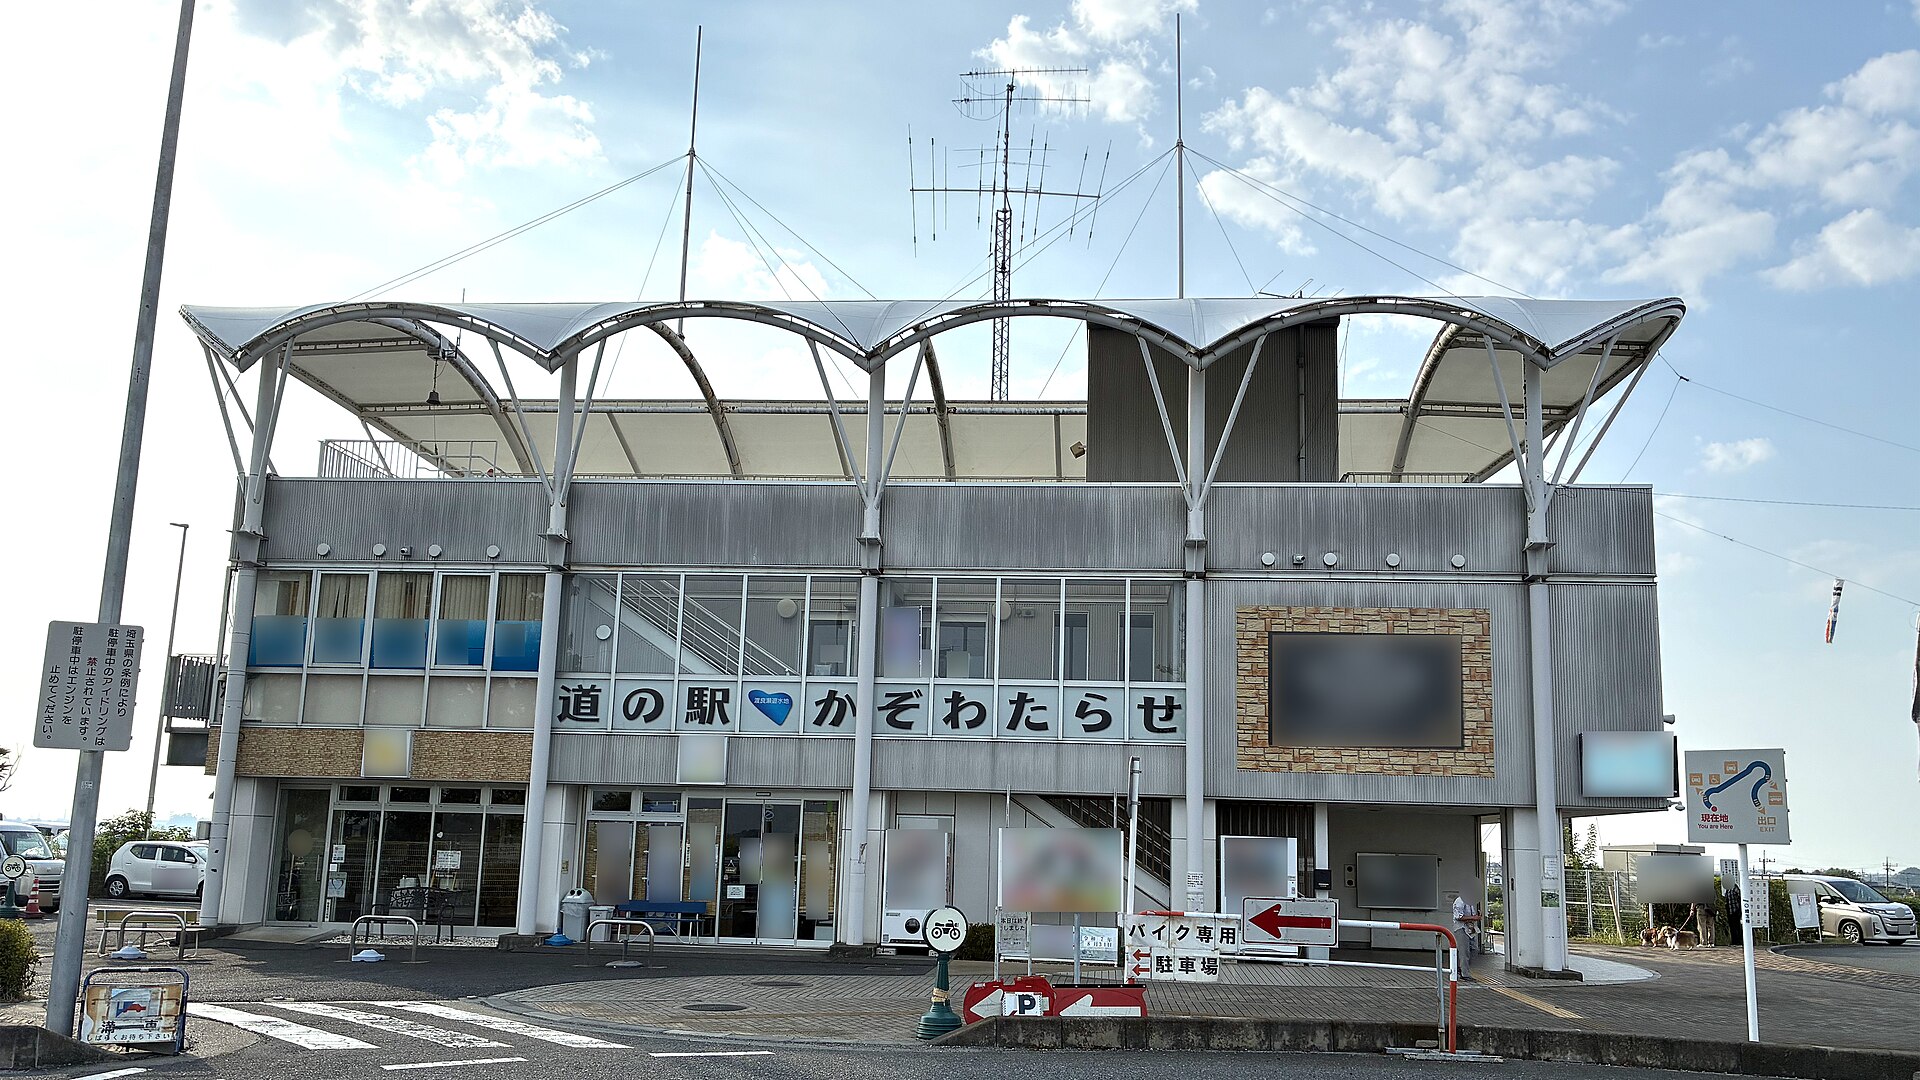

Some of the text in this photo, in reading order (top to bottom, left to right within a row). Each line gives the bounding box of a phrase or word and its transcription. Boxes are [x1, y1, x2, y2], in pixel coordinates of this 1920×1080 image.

[62, 626, 83, 725] 駐停車中はエンジンを
[94, 628, 119, 746] 駐停車中のアイドリングは
[117, 629, 137, 717] 埼玉県の条例により
[42, 665, 60, 740] 止めてください。
[79, 657, 98, 741] 禁止されています。
[556, 684, 1182, 734] 道の駅 かぞわたらせ
[1701, 813, 1729, 823] 現在地
[1757, 816, 1776, 826] 出口
[1128, 923, 1236, 945] バイク専用
[1155, 955, 1219, 976] 駐車場
[1017, 994, 1036, 1014] P
